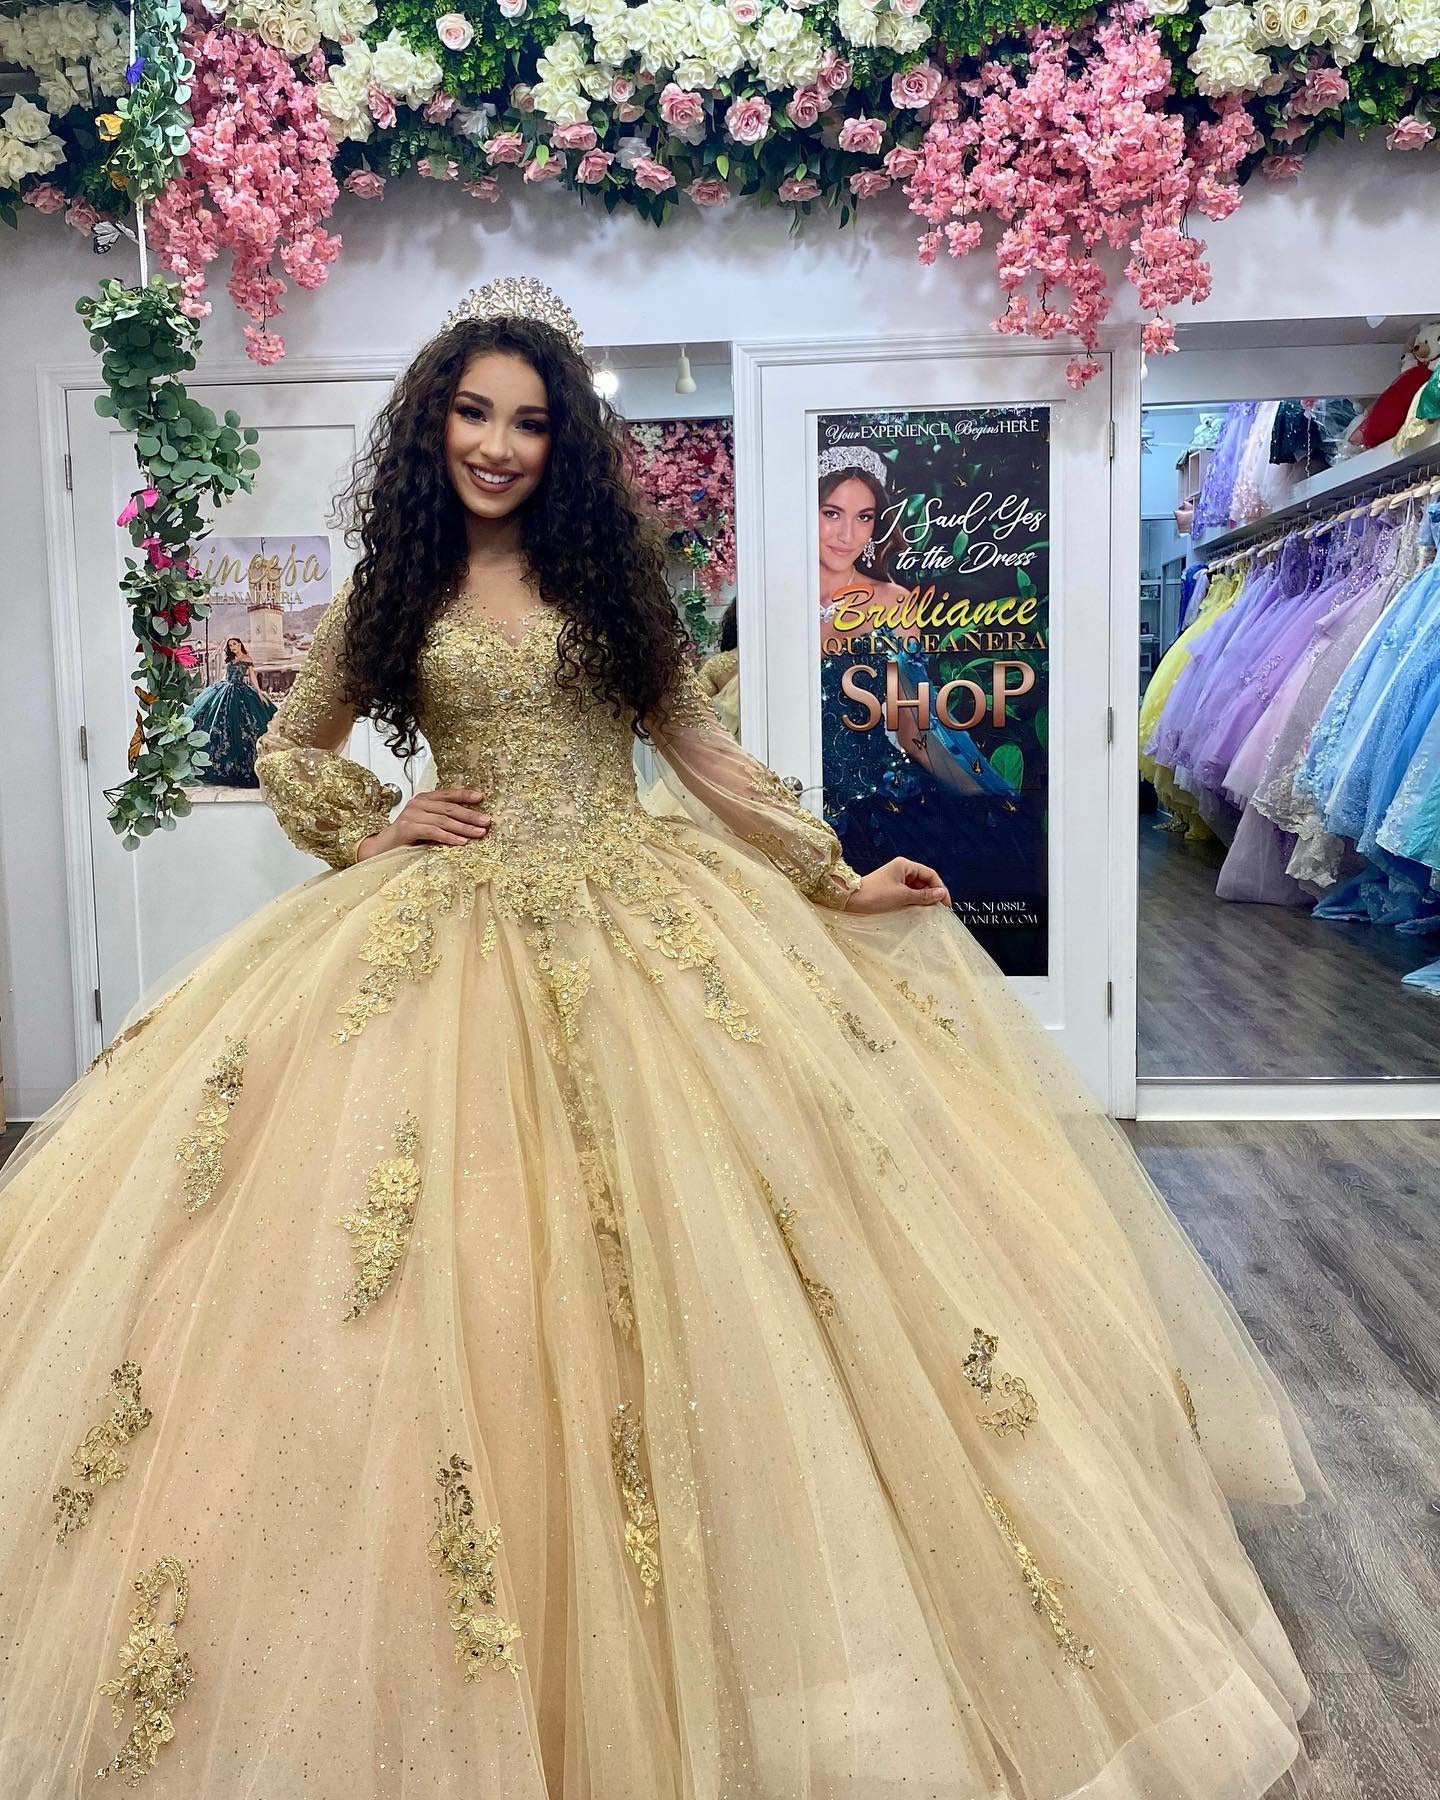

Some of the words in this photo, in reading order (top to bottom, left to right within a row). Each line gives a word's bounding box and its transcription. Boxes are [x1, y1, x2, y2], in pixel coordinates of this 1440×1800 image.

[825, 424, 860, 443] Your
[861, 422, 949, 439] EXPERIENCE
[954, 420, 999, 440] Begins
[1000, 419, 1039, 434] HERE
[903, 491, 992, 544] Said
[988, 494, 1046, 540] Yes
[189, 543, 329, 587] incesa
[896, 547, 921, 570] to
[921, 545, 955, 570] the
[958, 541, 1038, 574] Dress
[832, 582, 1038, 631] Brilliance
[823, 629, 1048, 656] QUINCEAÑERA
[841, 660, 1036, 732] SHOP
[951, 901, 980, 912] OOK,
[982, 901, 994, 913] NJ
[996, 901, 1027, 911] 08812
[962, 914, 1038, 924] EANERA.COM
